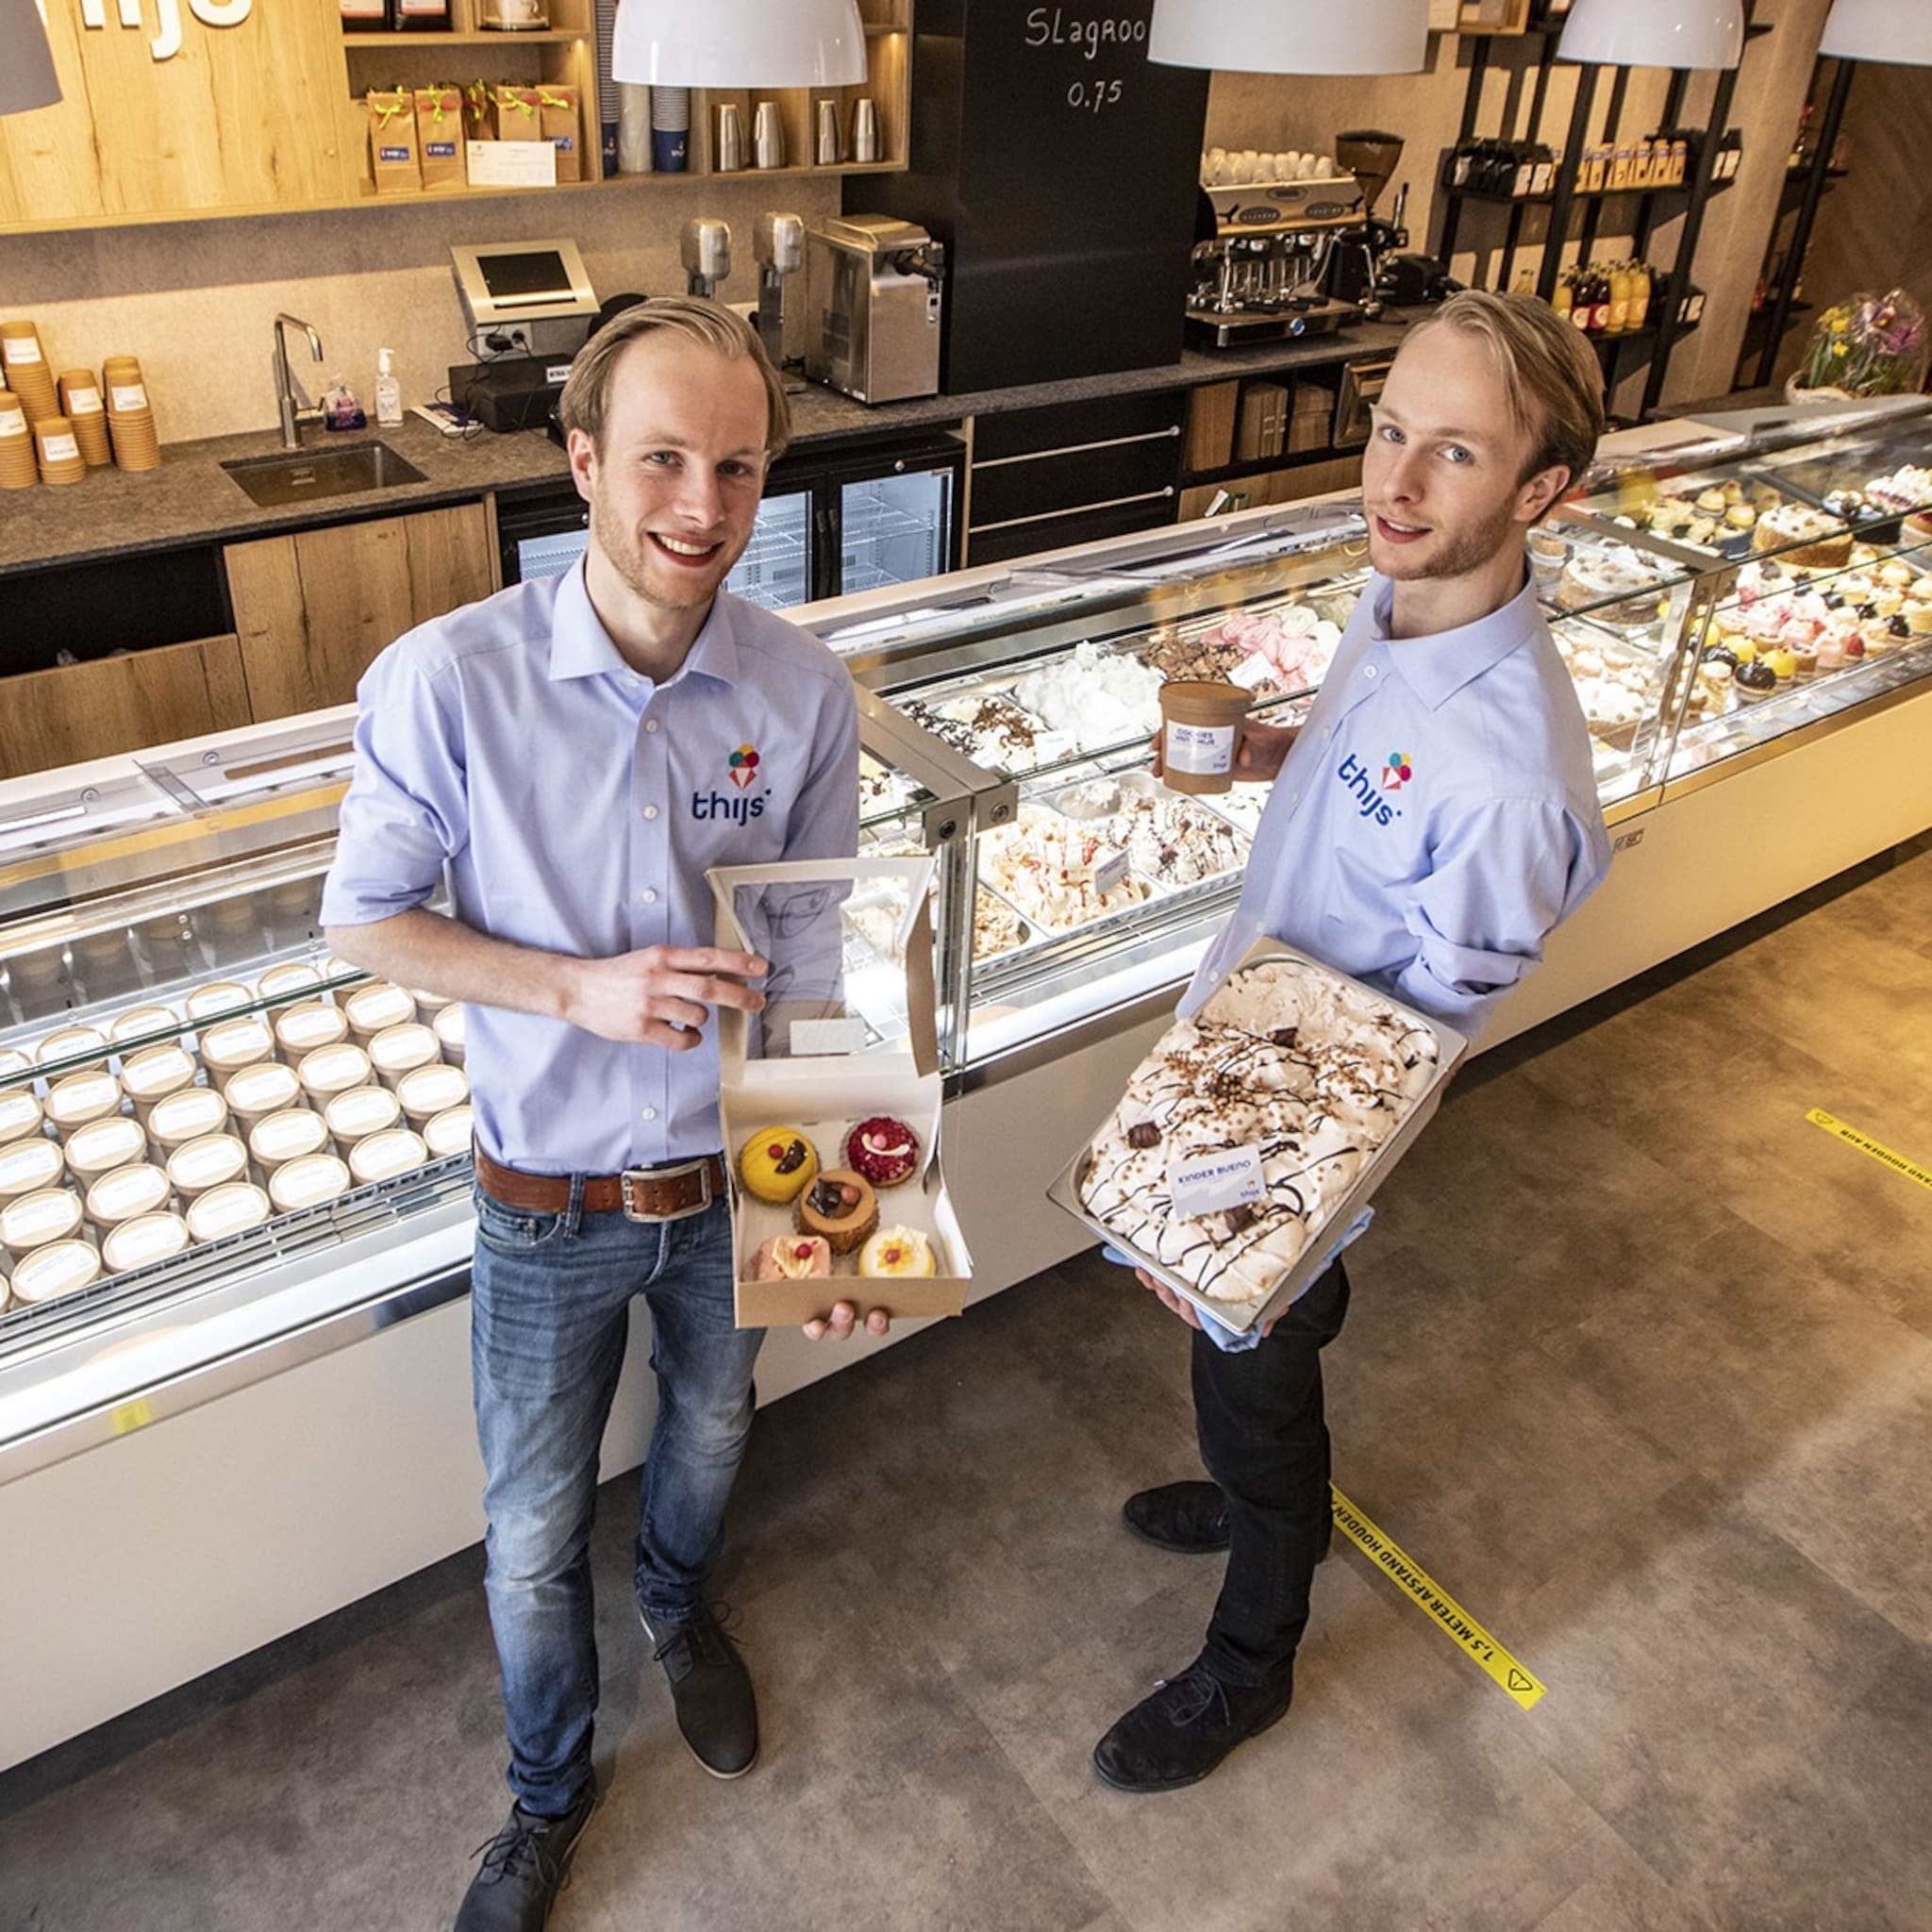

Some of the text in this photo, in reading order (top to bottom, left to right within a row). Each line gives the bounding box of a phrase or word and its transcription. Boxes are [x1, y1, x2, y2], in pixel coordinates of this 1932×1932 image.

[691, 791, 764, 827] thijs
[1338, 753, 1393, 826] thijs
[1177, 1159, 1252, 1184] KINDER BUENO
[1333, 1506, 1383, 1553] HOUDEN
[1378, 1551, 1435, 1601] AFSTAND
[1429, 1598, 1475, 1641] METER
[1469, 1640, 1494, 1662] 1,5
